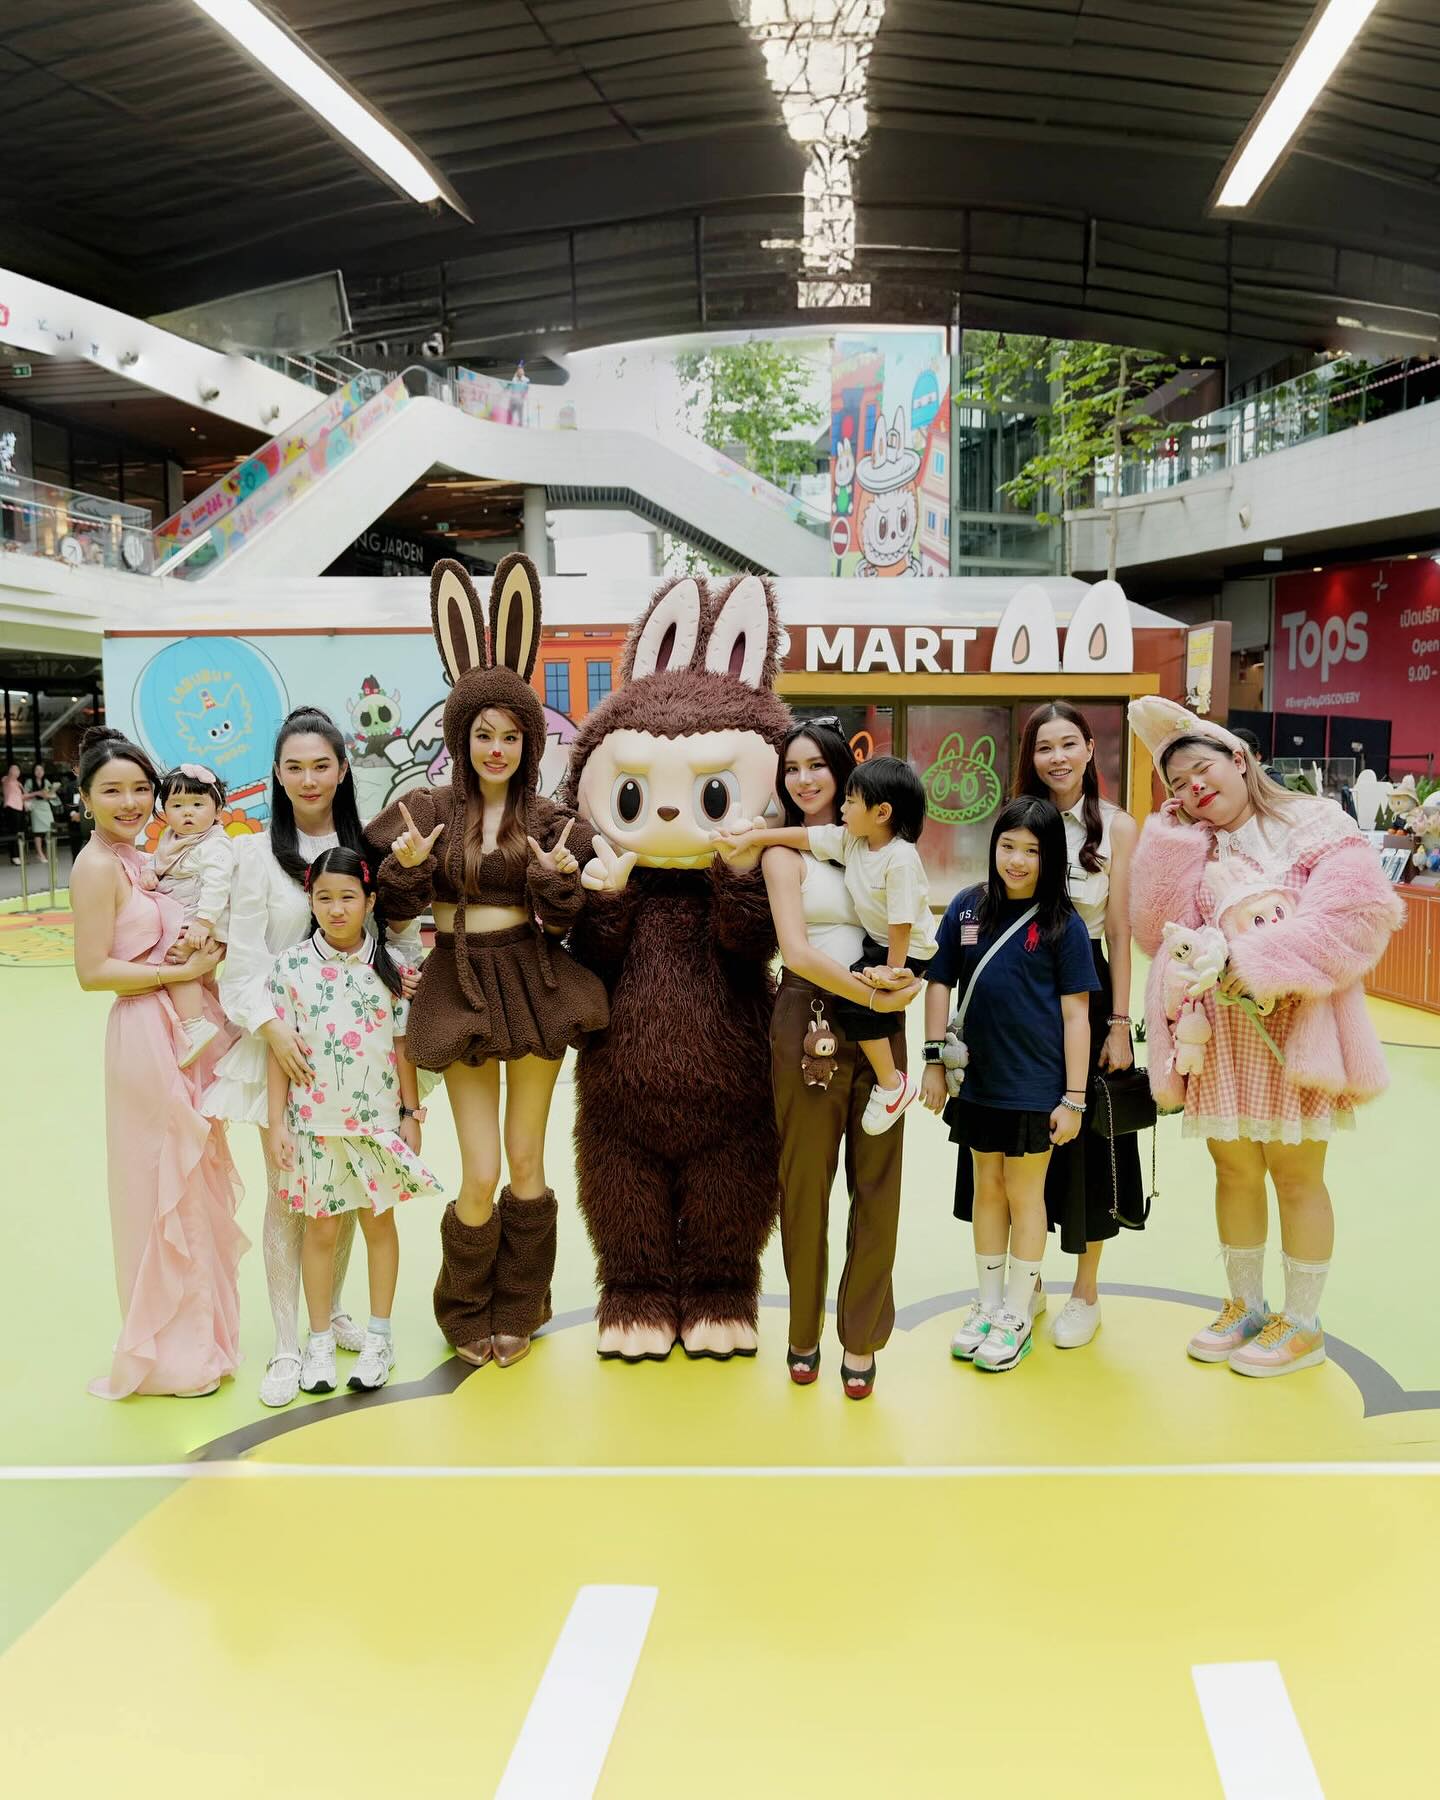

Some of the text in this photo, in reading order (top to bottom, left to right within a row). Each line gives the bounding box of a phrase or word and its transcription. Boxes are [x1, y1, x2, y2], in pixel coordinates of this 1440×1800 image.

[1400, 605, 1440, 628] เปิดบริก
[805, 626, 977, 673] MART
[1281, 610, 1369, 683] Tops
[1411, 638, 1440, 656] Open
[1285, 691, 1361, 709] #EveryDayDISCOVERY
